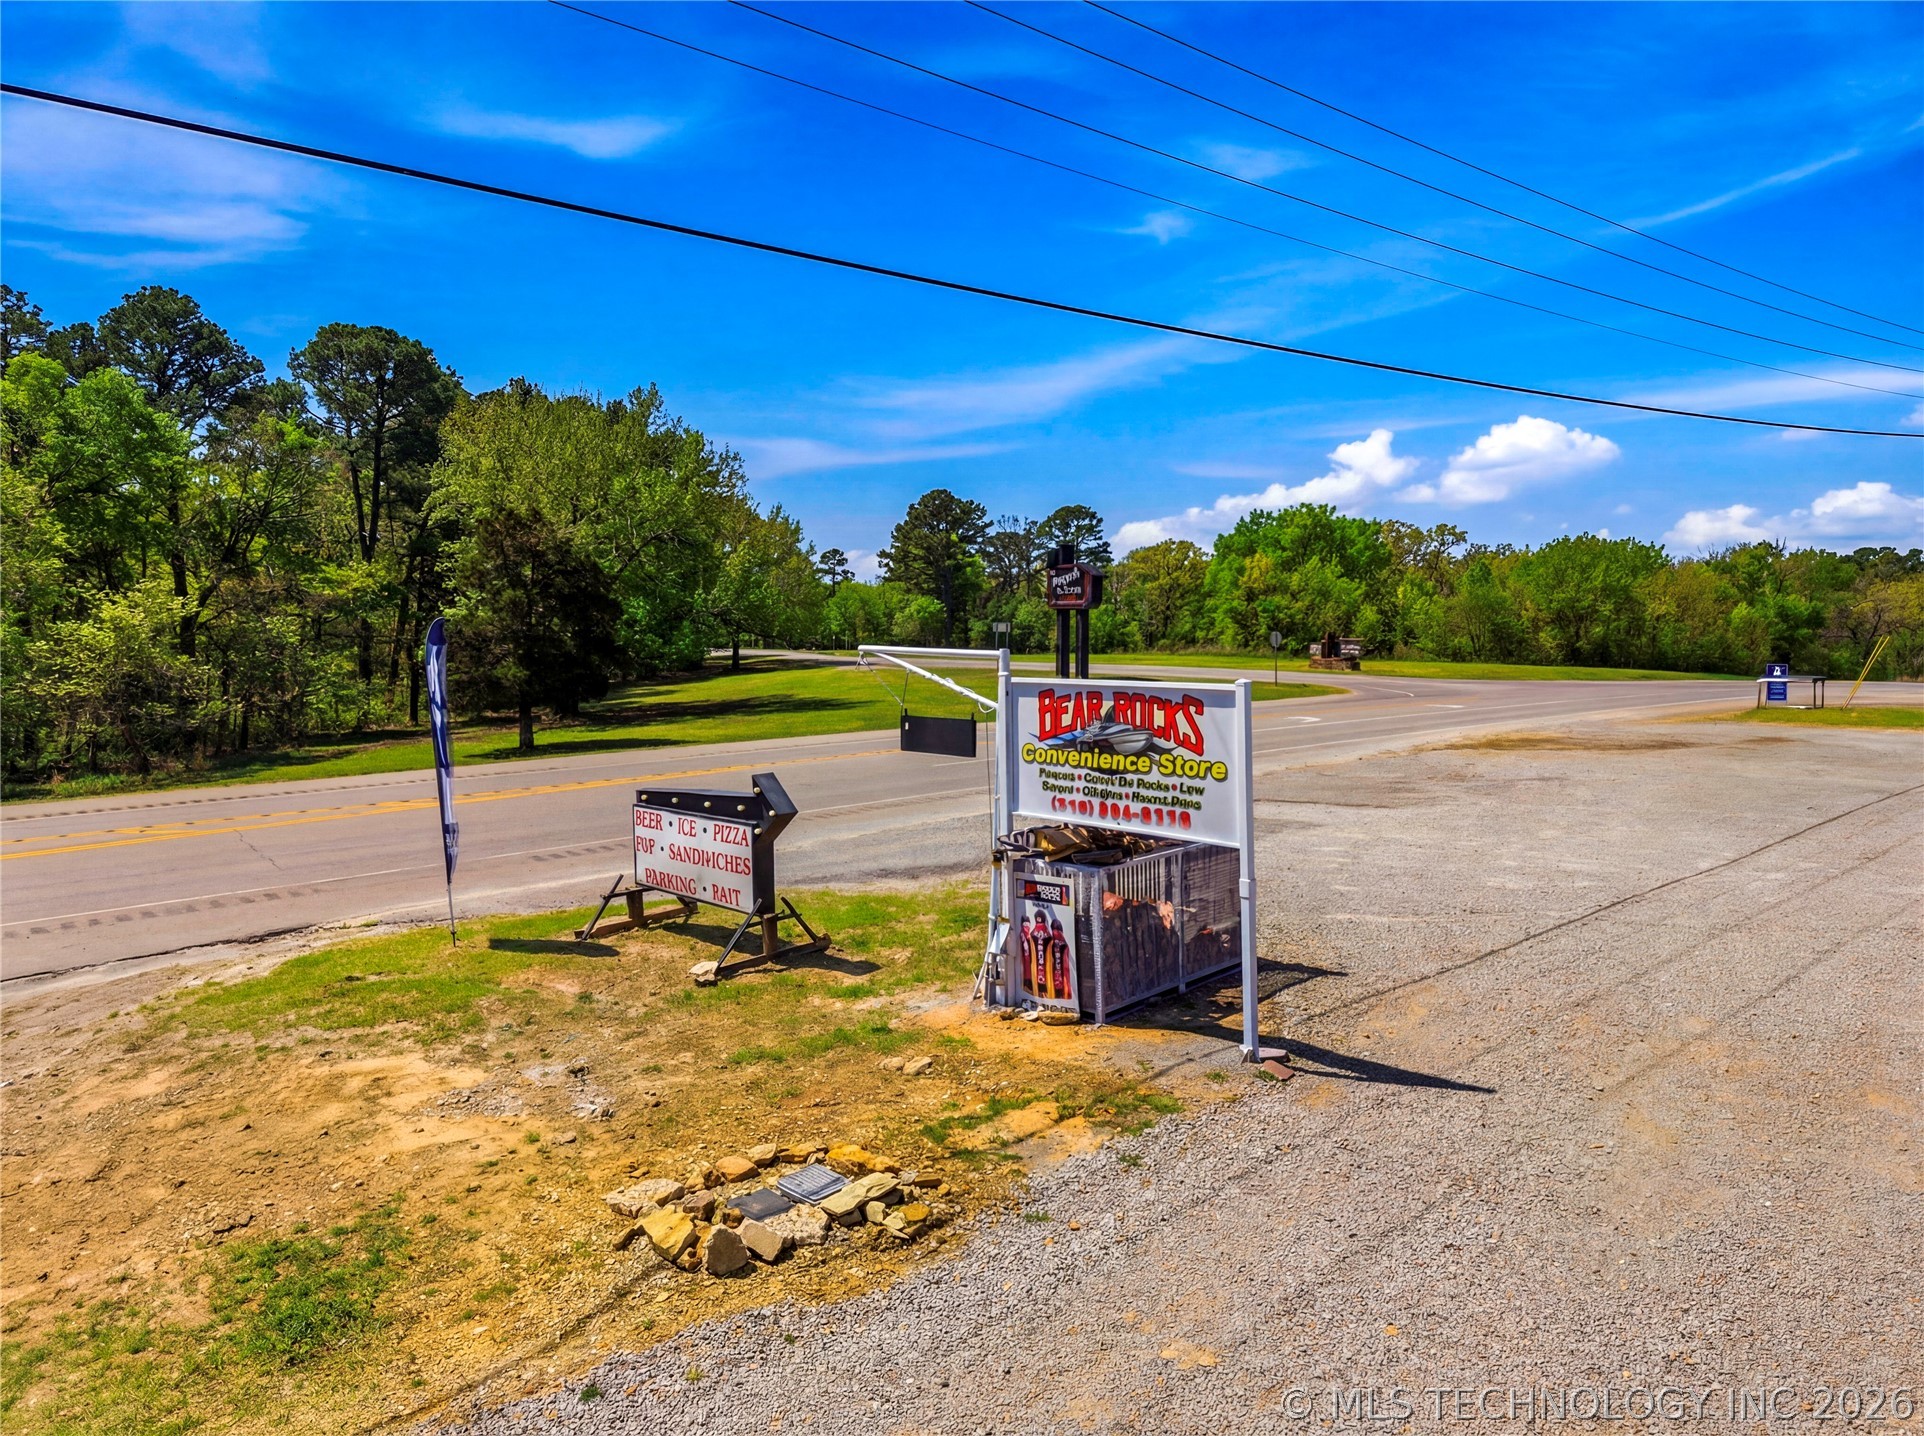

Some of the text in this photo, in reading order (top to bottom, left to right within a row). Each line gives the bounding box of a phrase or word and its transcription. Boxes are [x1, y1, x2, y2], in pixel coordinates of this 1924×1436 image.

[1038, 688, 1204, 757] BEAR ROCKS
[1021, 742, 1228, 780] Convenience Store
[635, 809, 750, 847] BEER ICE PIZZA
